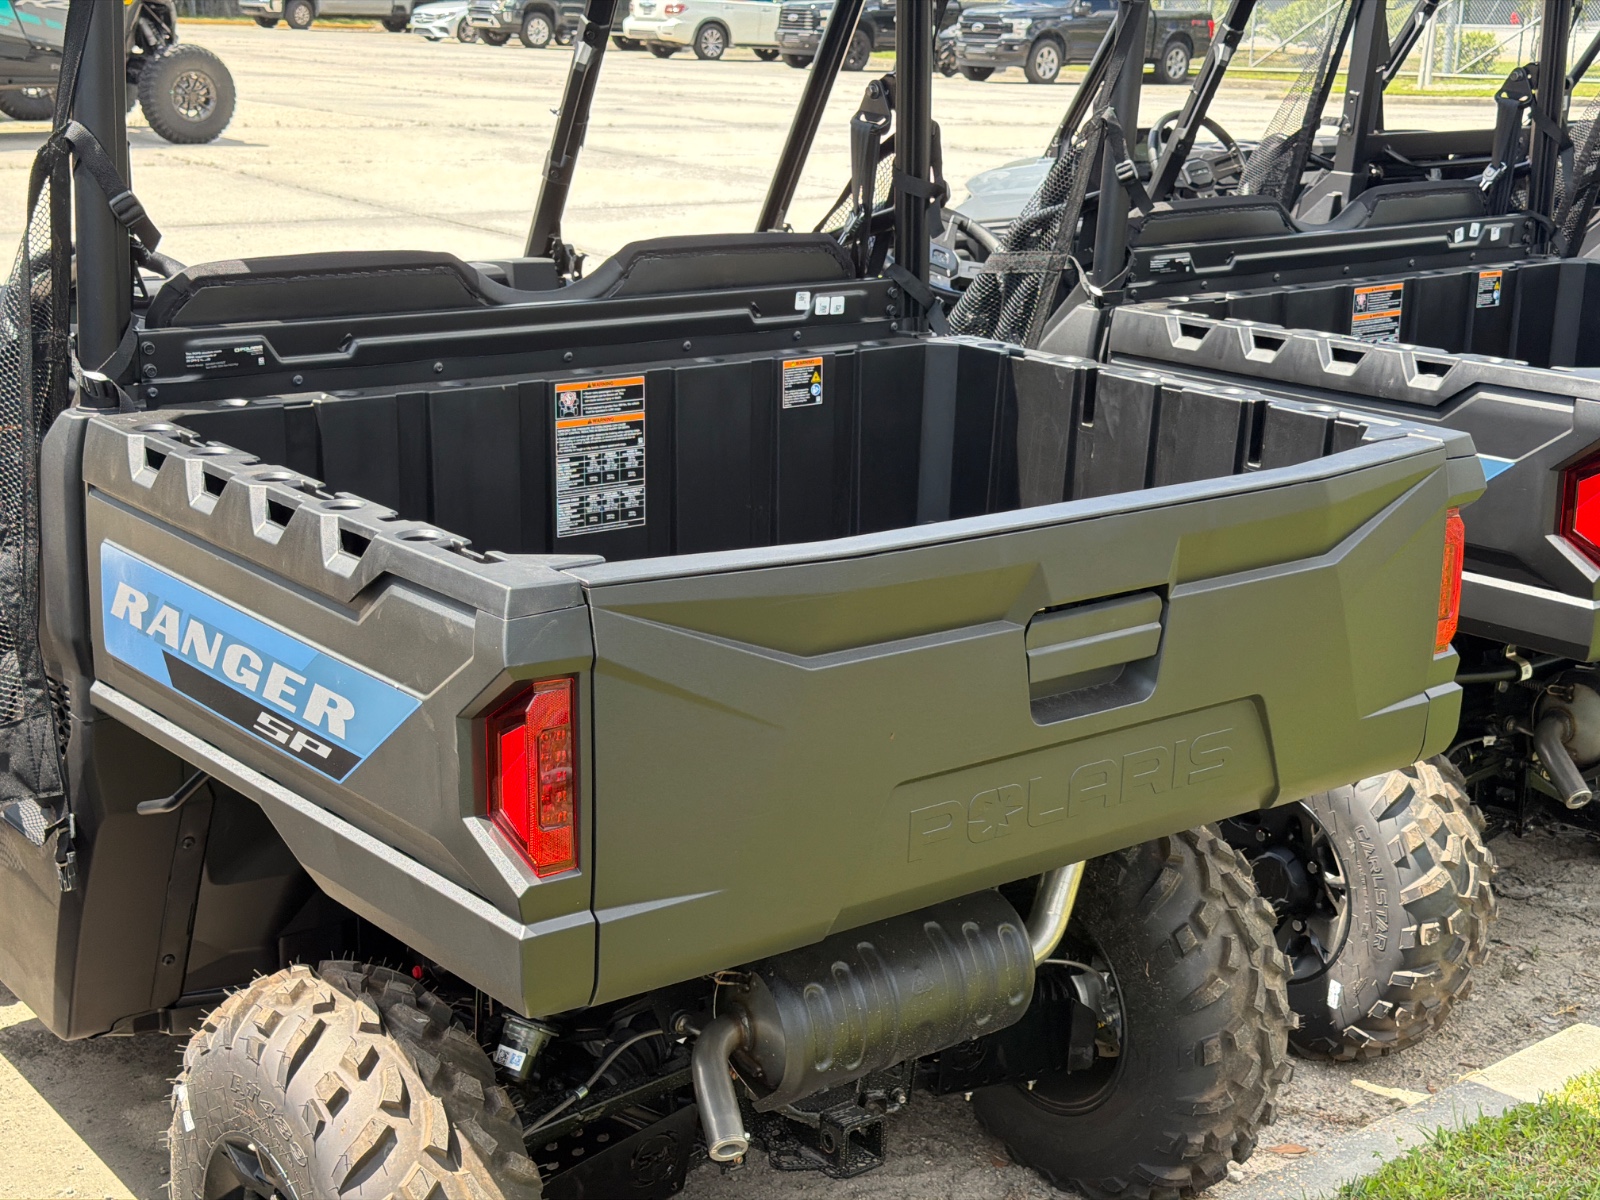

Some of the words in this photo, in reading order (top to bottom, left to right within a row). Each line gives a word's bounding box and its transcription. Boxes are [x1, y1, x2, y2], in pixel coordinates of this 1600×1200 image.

[110, 581, 355, 740] RANGER
[253, 711, 332, 759] SP
[907, 728, 1233, 863] POLARIS
[1355, 824, 1391, 952] CARLSTAR
